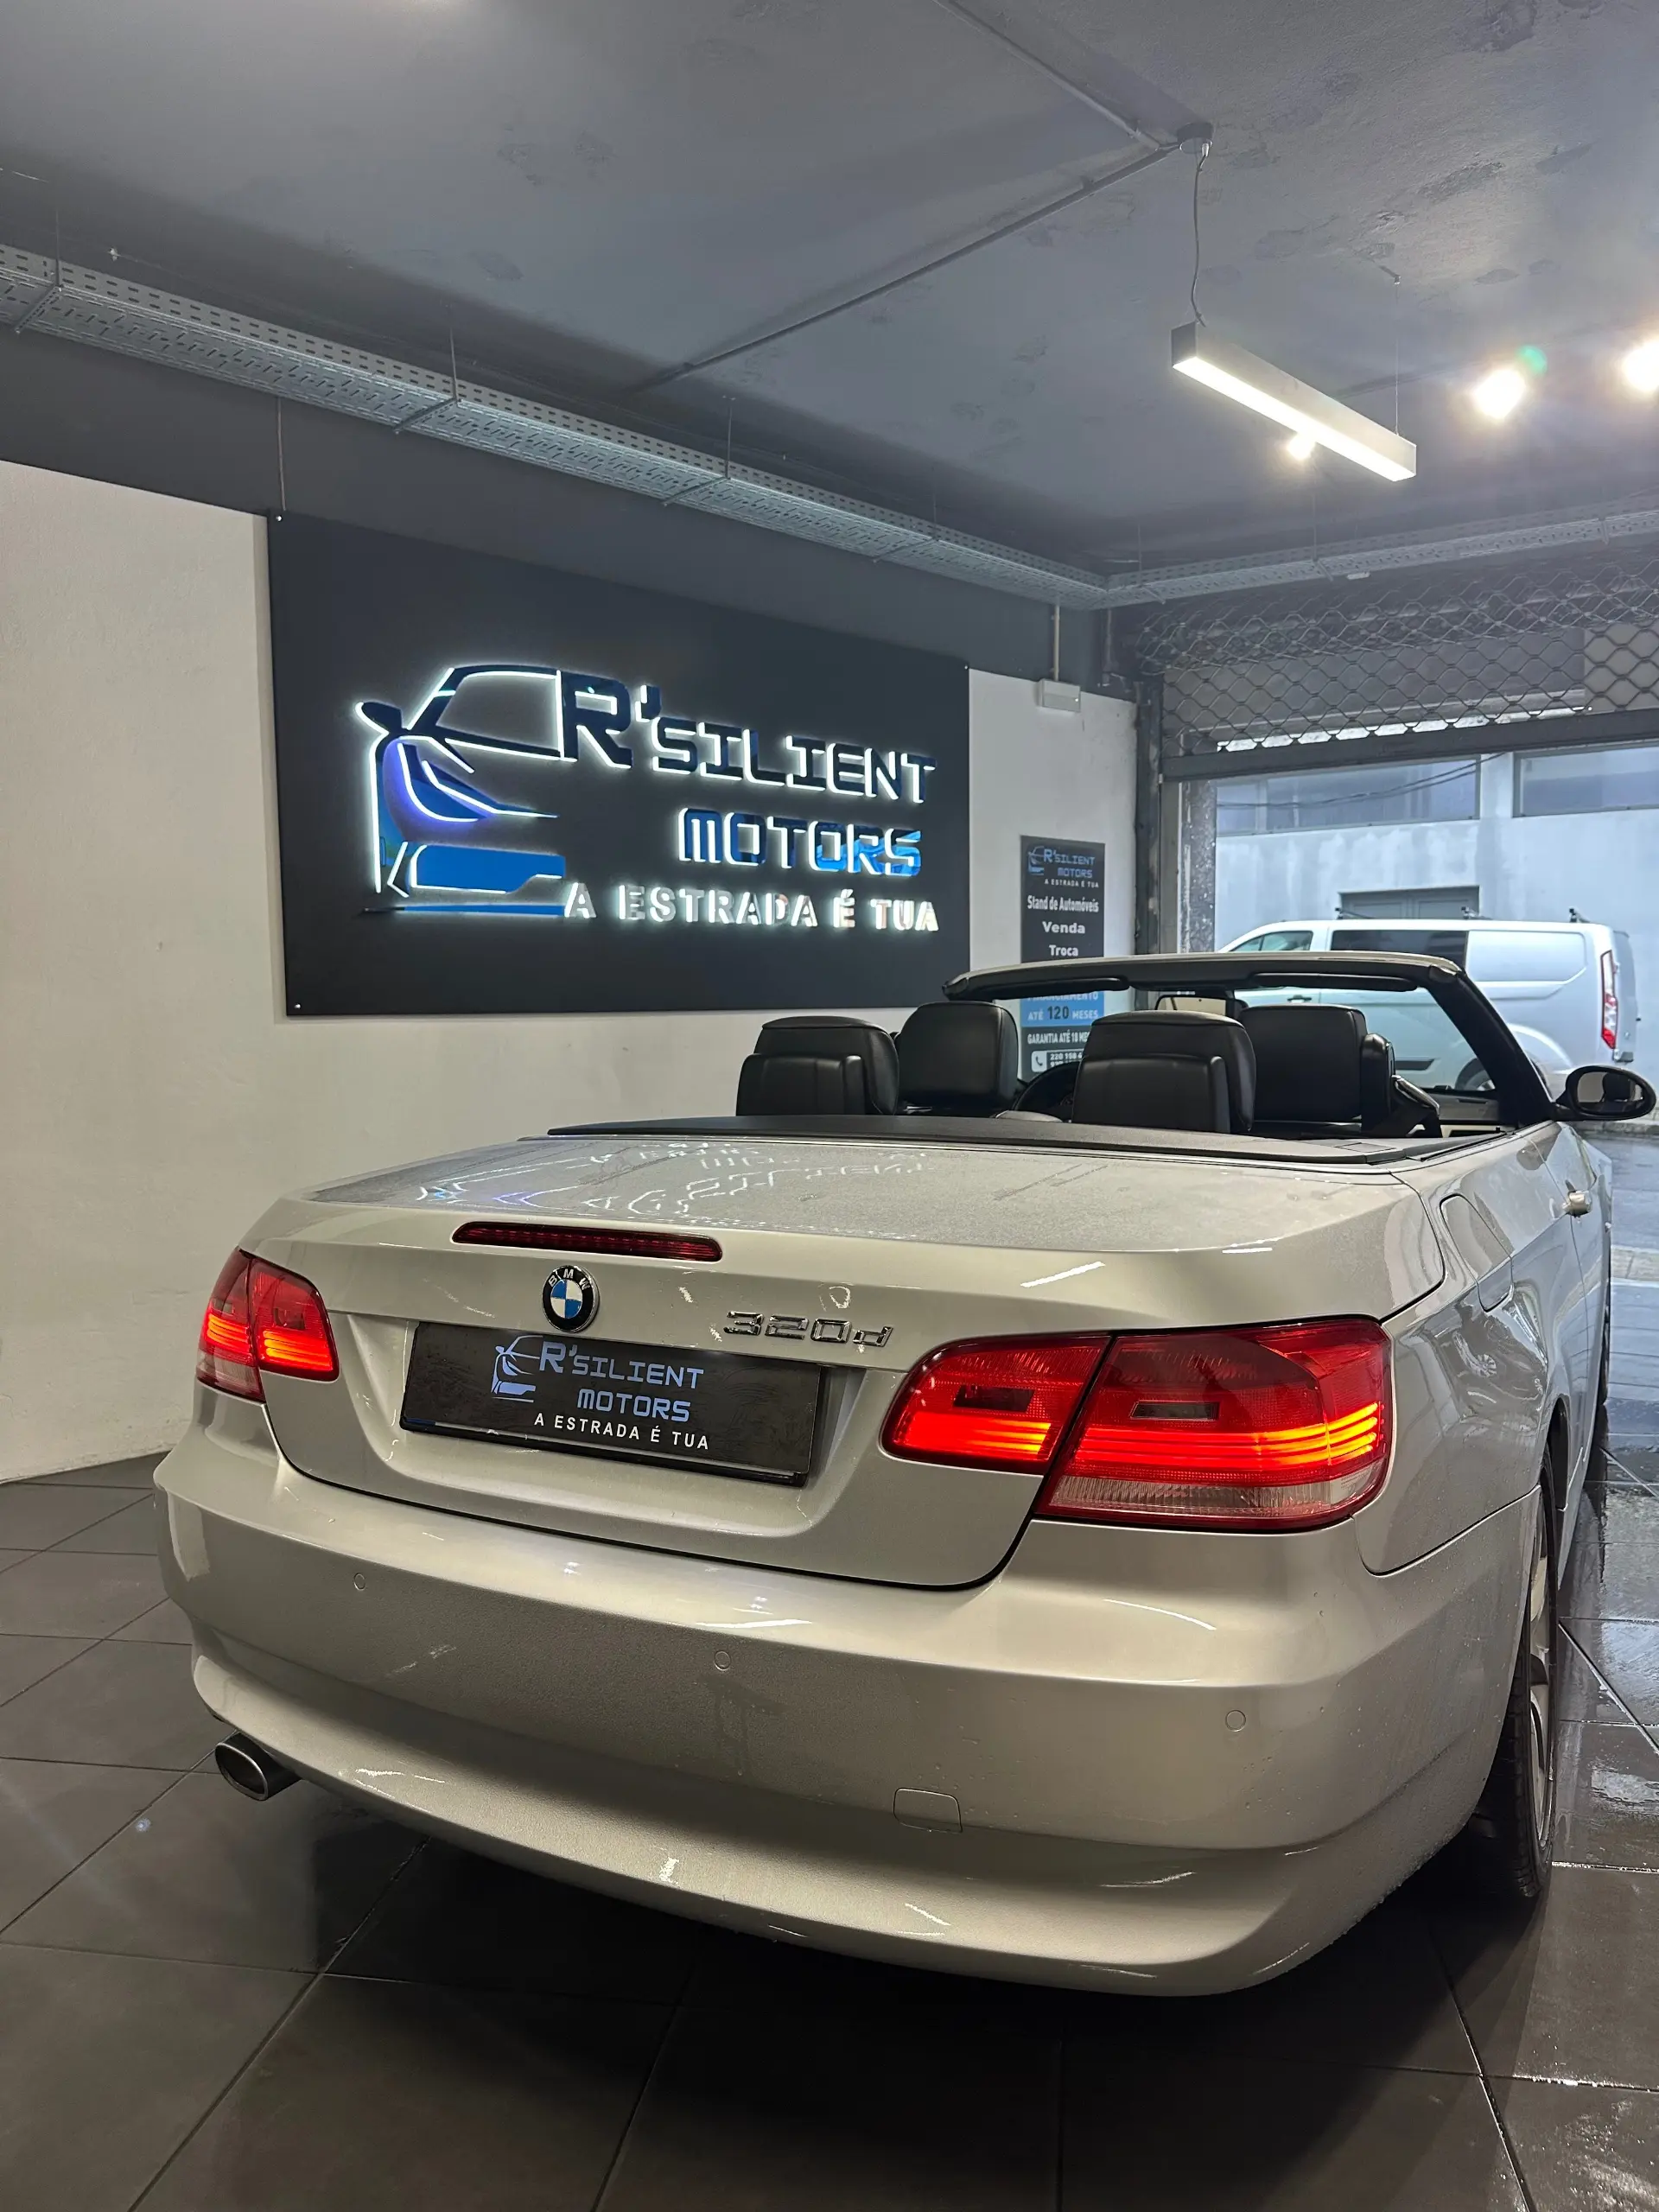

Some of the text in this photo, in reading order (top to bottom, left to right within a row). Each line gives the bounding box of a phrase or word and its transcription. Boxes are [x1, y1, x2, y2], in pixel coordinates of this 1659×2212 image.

[558, 669, 937, 804] R'SILIENT
[678, 807, 923, 878] MOTORS
[1058, 868, 1092, 878] MOTORS
[563, 881, 939, 932] A ESTRADA É TUA
[1027, 894, 1099, 912] Stand de Automóveis
[1042, 921, 1086, 934] Venda
[1049, 944, 1078, 957] Troca
[1027, 1005, 1099, 1020] ATÉ 120 MESES
[1027, 1032, 1058, 1045] GARANTIA
[1058, 1029, 1071, 1044] ATÉ
[548, 1268, 591, 1290] BMW
[723, 1311, 894, 1348] 320d
[539, 1341, 704, 1389] R'SILIENT
[576, 1388, 691, 1423] MOTORS
[534, 1413, 709, 1450] A ESTRADA É TUA
